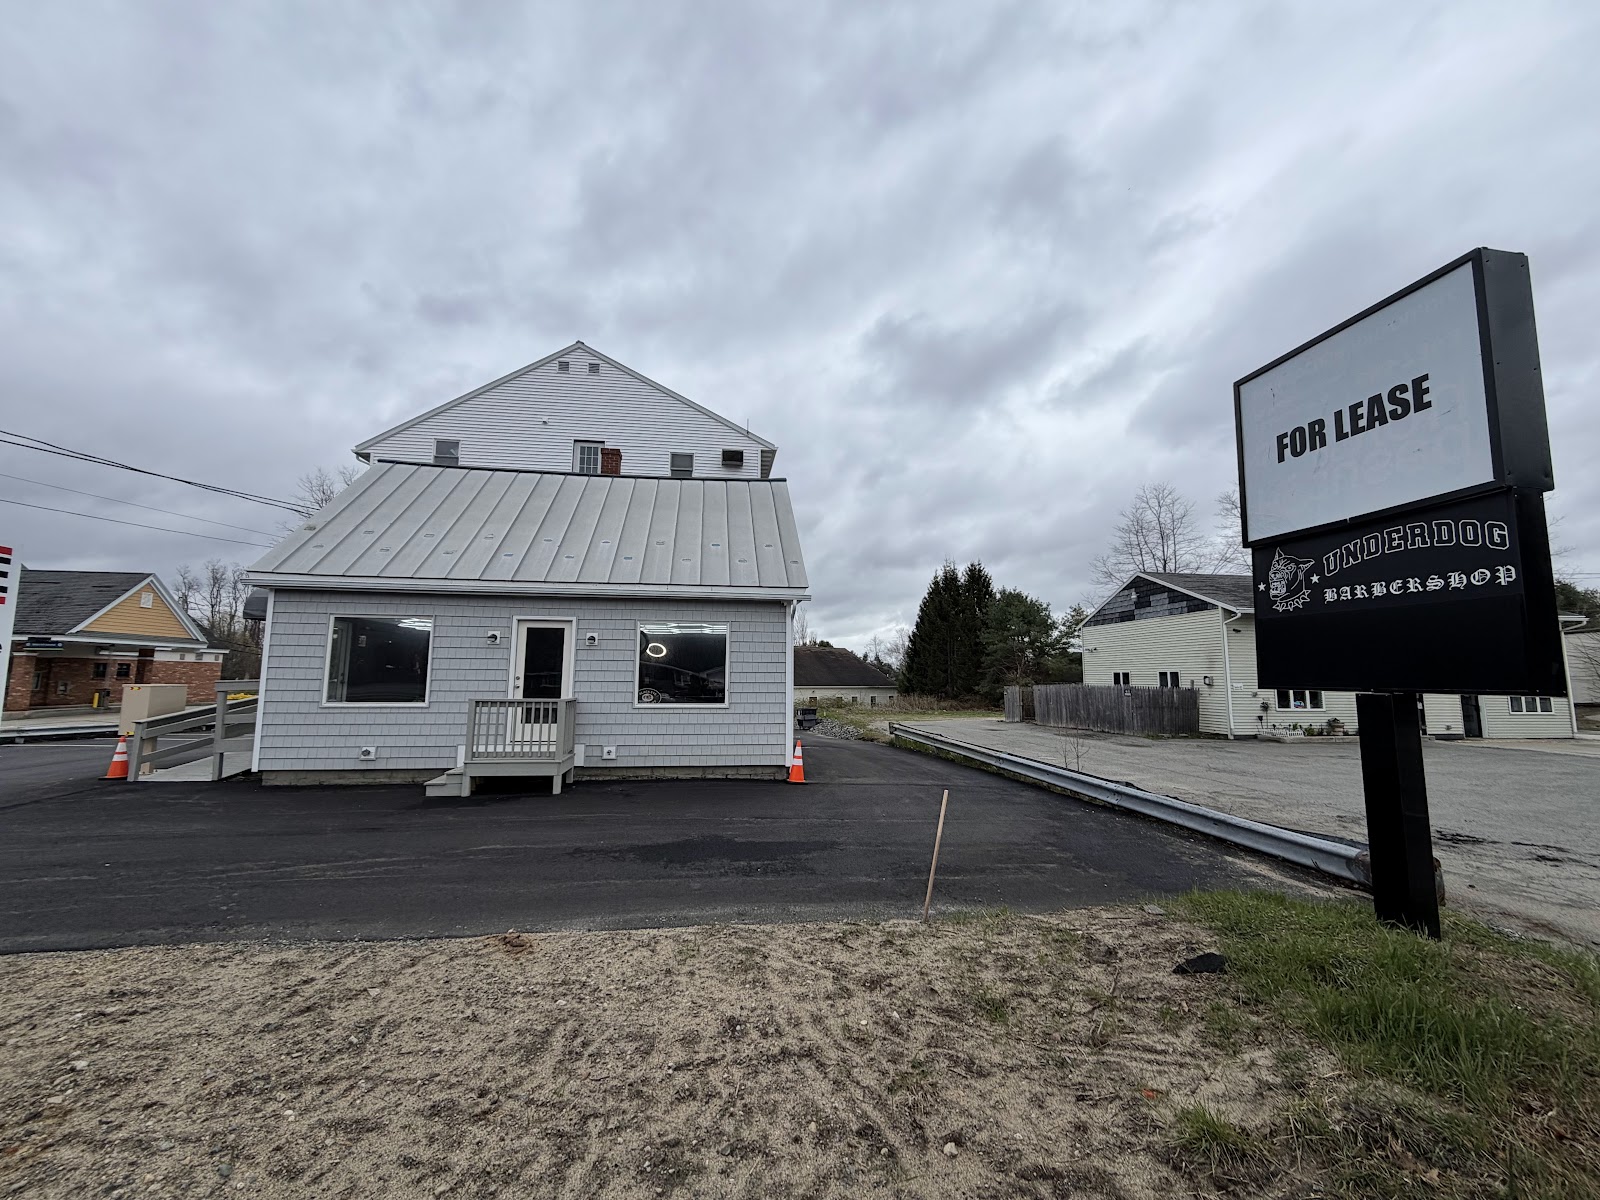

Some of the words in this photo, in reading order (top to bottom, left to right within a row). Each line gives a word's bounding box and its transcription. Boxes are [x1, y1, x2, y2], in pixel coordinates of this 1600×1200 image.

[1276, 418, 1327, 463] FOR
[1333, 373, 1432, 442] LEASE
[1322, 519, 1510, 577] UNDERDOG
[1323, 565, 1517, 604] BARBERSHOP
